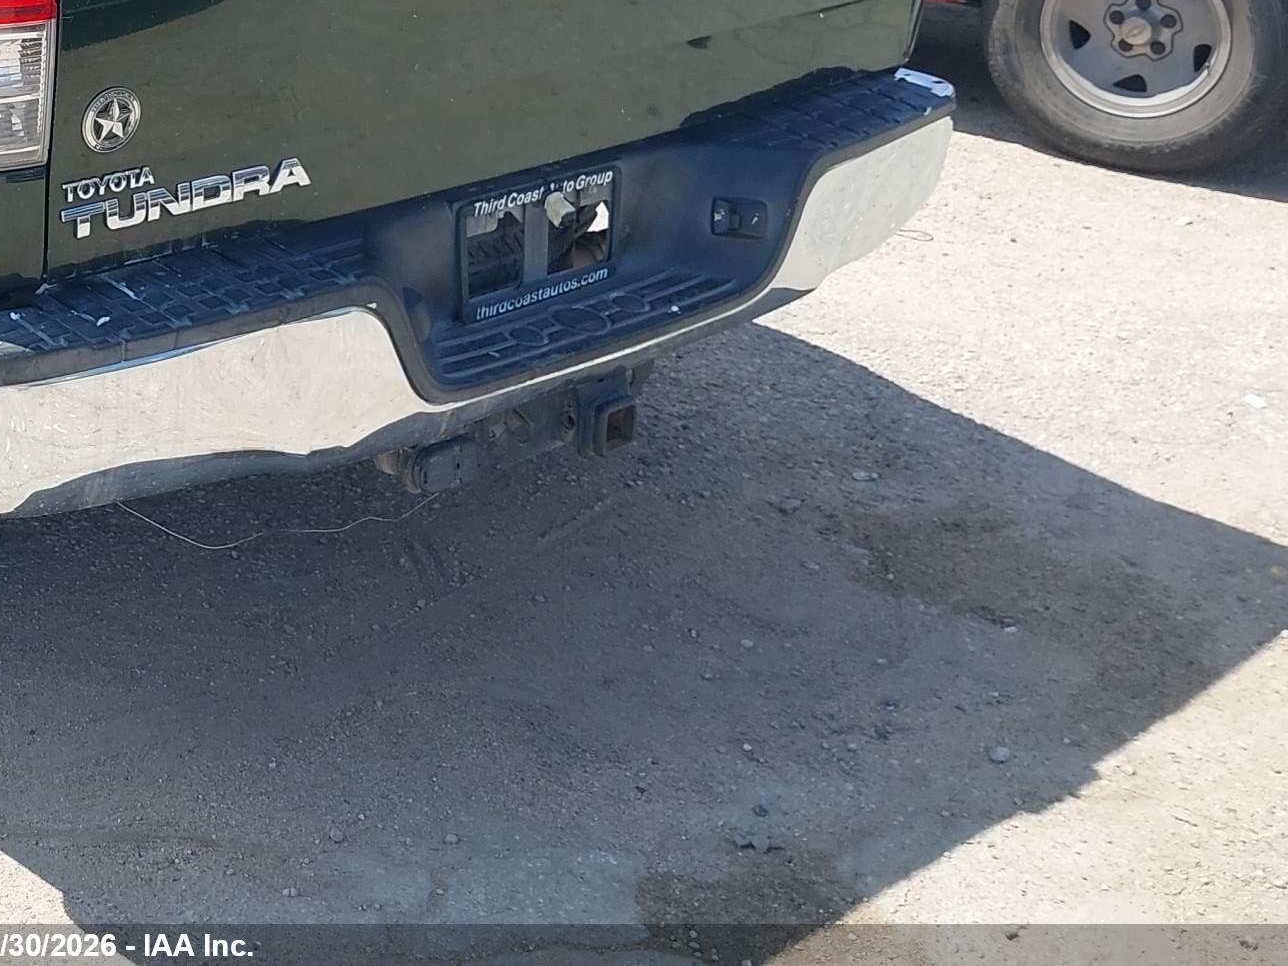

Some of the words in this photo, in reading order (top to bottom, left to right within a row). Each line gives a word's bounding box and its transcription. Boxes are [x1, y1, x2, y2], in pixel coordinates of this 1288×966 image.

[61, 157, 311, 239] TUNDRA
[62, 166, 155, 202] TOYOTA
[474, 197, 507, 217] Third
[507, 187, 545, 207] Coast
[575, 170, 613, 190] Group
[476, 267, 609, 320] thirdcoastautos.com
